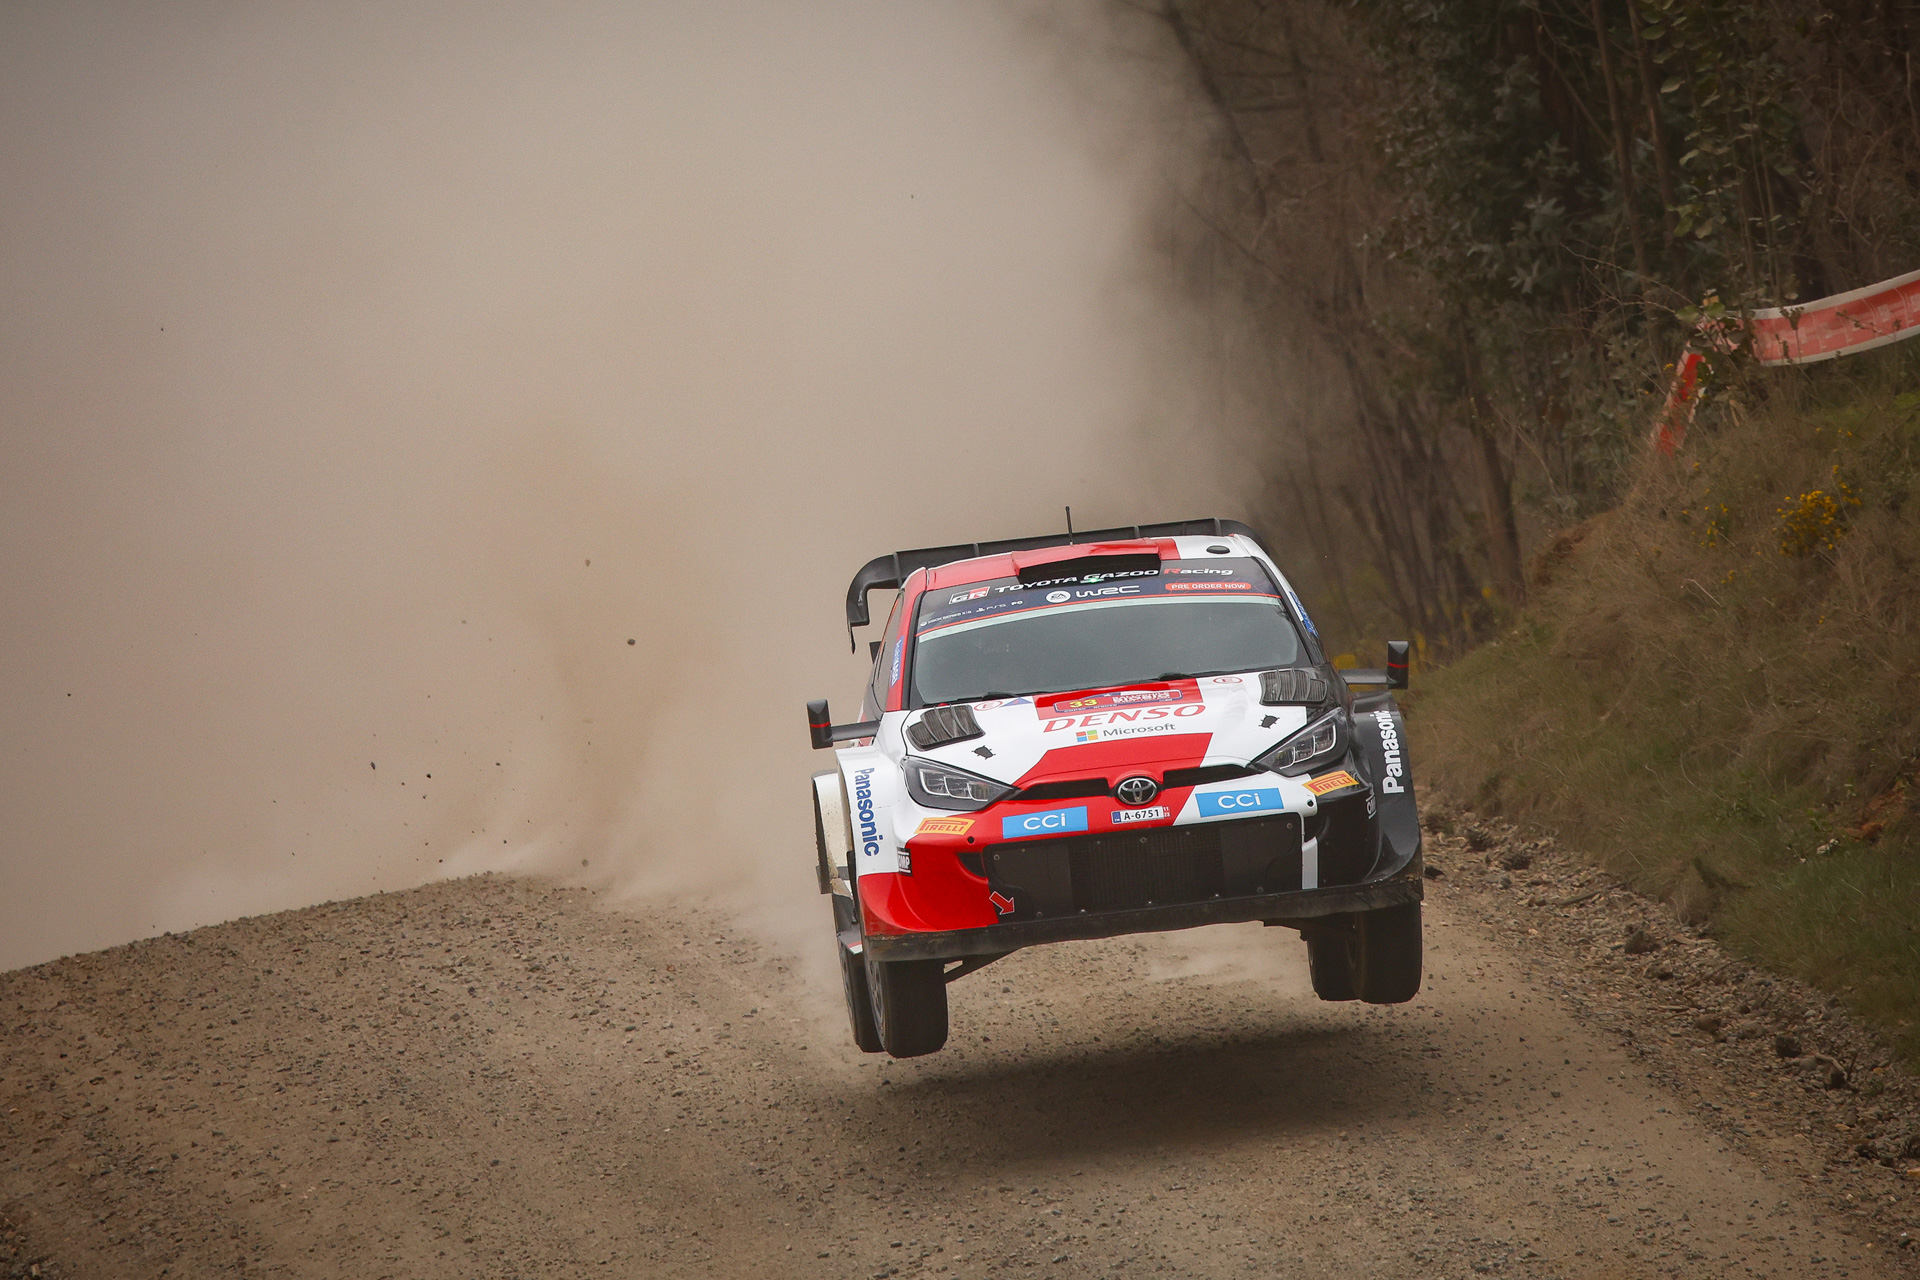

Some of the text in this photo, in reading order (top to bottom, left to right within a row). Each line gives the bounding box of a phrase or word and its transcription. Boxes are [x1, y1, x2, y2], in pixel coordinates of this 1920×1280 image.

[950, 568, 1234, 604] GR TOYOTA GAZOO Racing
[1076, 585, 1141, 598] WRC
[1069, 699, 1098, 708] 33
[1043, 705, 1206, 733] DENSO
[1103, 722, 1176, 737] Microsoft
[1308, 774, 1353, 793] PIRELLI
[855, 767, 883, 856] Panasonic
[1124, 809, 1159, 820] A-6751
[919, 820, 968, 832] PIRELLI
